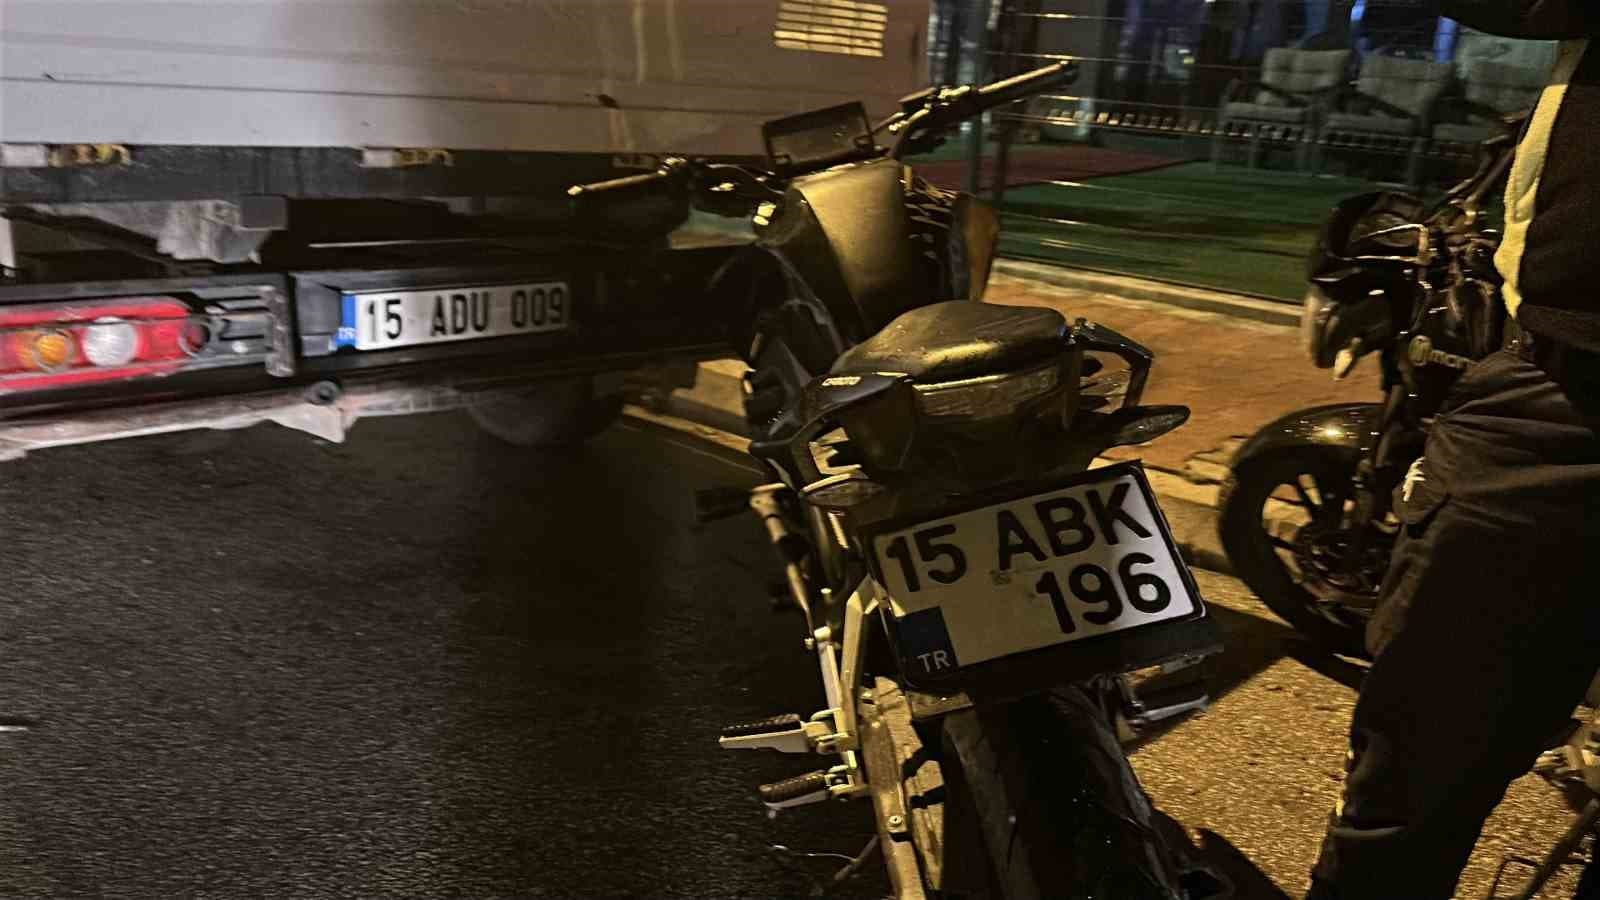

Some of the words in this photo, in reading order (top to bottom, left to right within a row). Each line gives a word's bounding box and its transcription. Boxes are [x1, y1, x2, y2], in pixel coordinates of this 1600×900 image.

[367, 298, 403, 343] 15
[431, 291, 490, 337] ADU
[511, 287, 565, 329] 009
[886, 524, 968, 593] 15
[997, 482, 1153, 570] ABK
[1035, 551, 1172, 634] 196
[917, 650, 951, 673] TR
